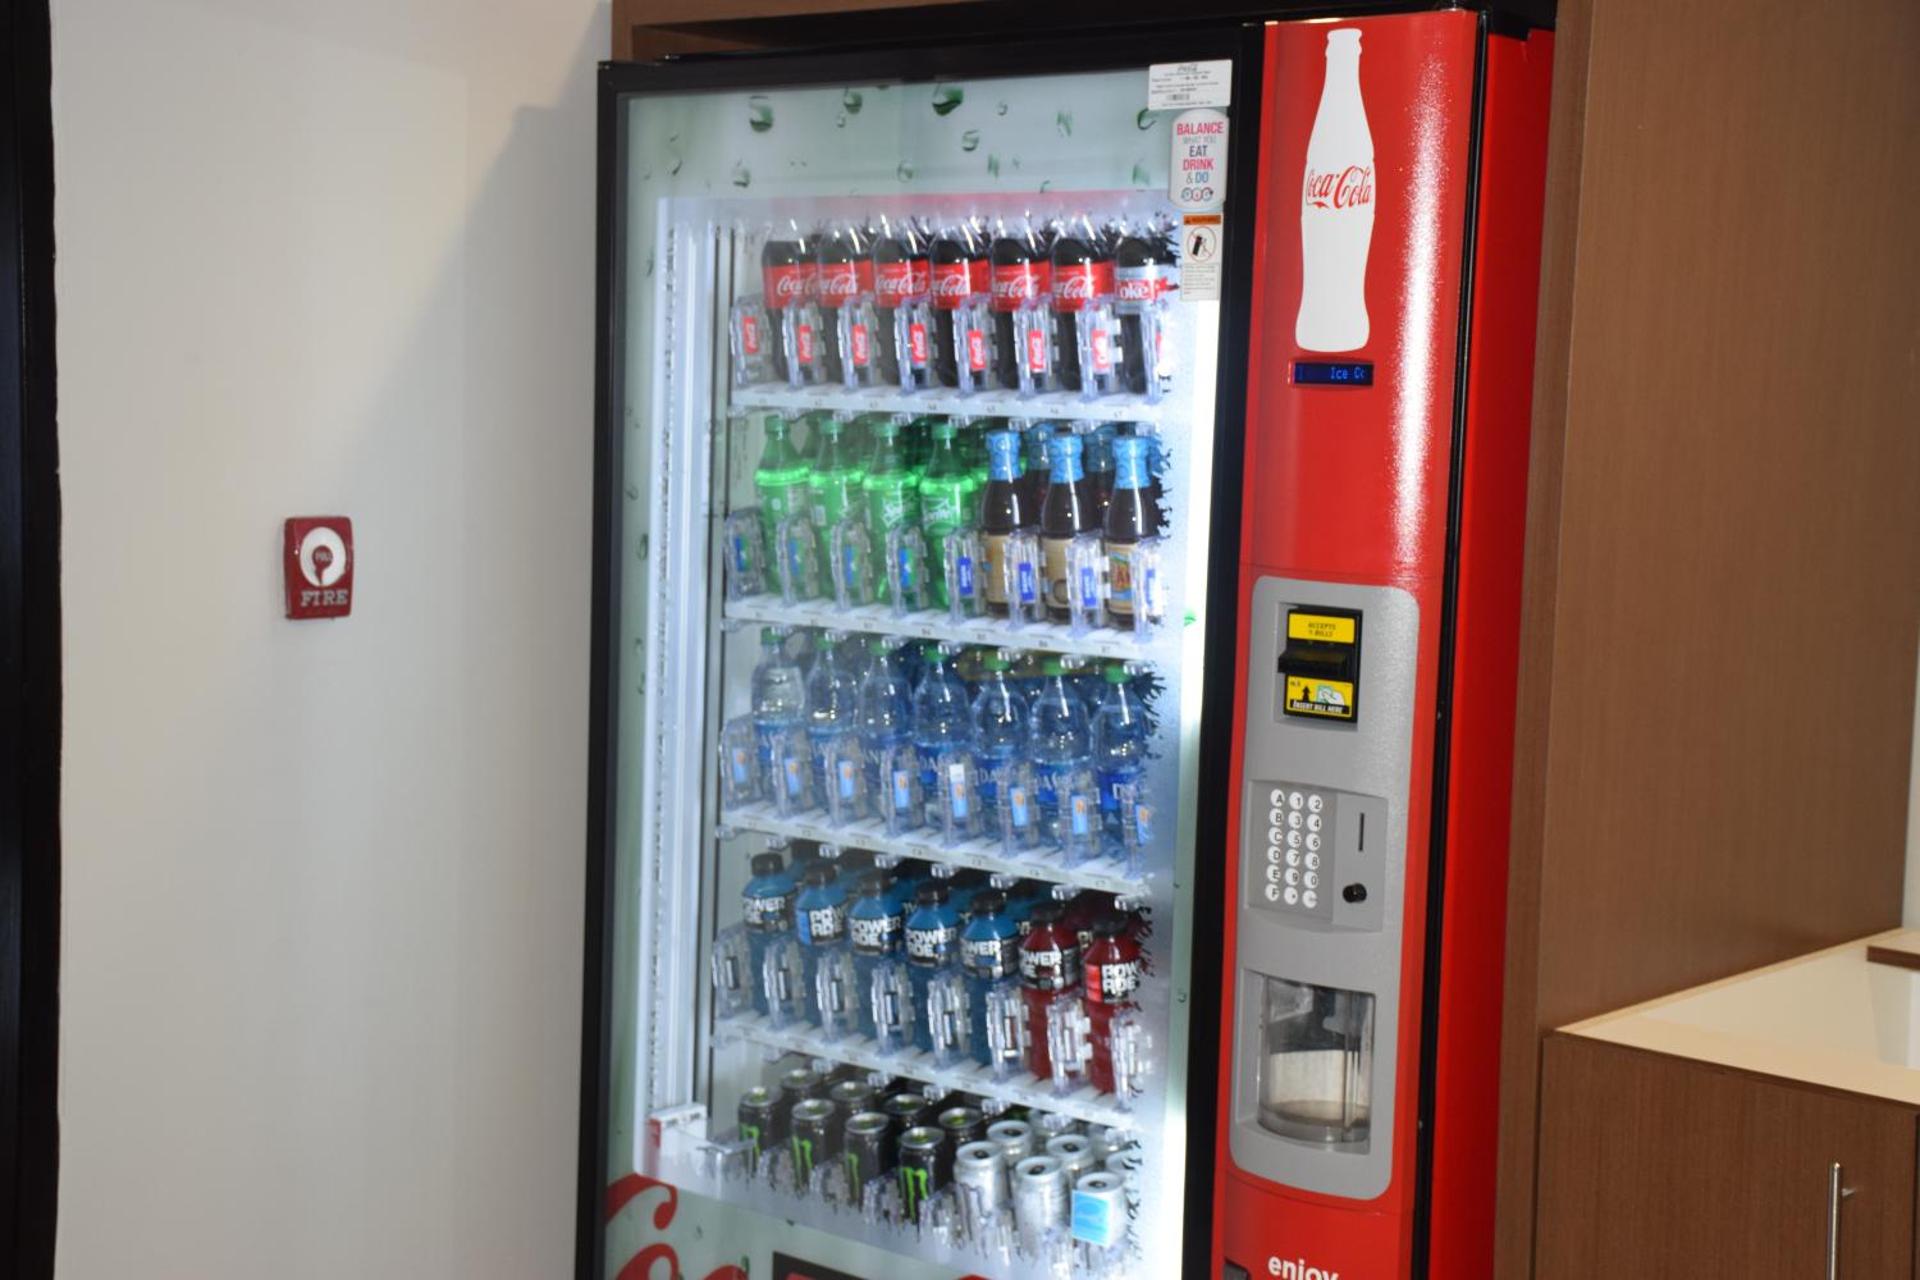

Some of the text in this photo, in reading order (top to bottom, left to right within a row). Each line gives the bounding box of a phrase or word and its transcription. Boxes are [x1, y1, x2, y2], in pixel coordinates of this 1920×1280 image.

[1177, 122, 1223, 136] BALANCE
[1189, 145, 1208, 157] EAT
[1183, 159, 1214, 171] DRINK
[1195, 171, 1209, 183] DO
[1331, 366, 1348, 380] Ice
[301, 590, 348, 607] FIRE
[1102, 962, 1137, 978] POW
